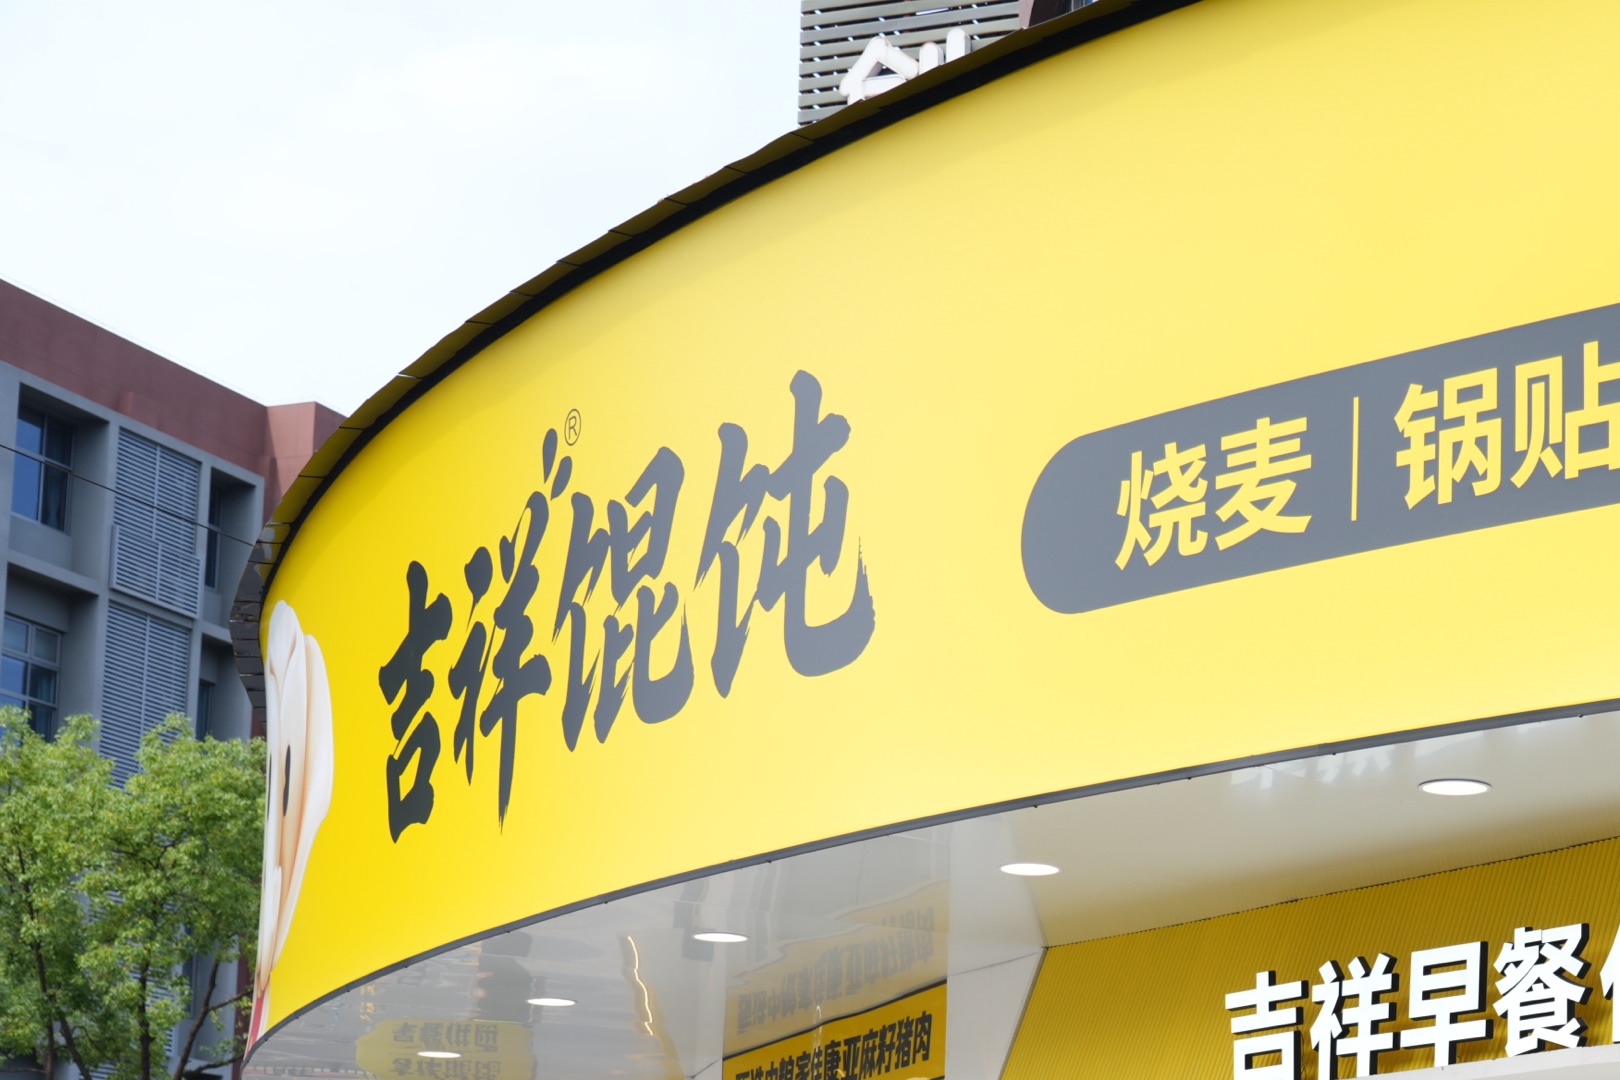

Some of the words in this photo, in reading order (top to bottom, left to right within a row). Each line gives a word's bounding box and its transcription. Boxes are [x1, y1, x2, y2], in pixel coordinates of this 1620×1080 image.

[379, 370, 875, 844] 吉祥馄饨
[1114, 414, 1314, 571] 烧麦
